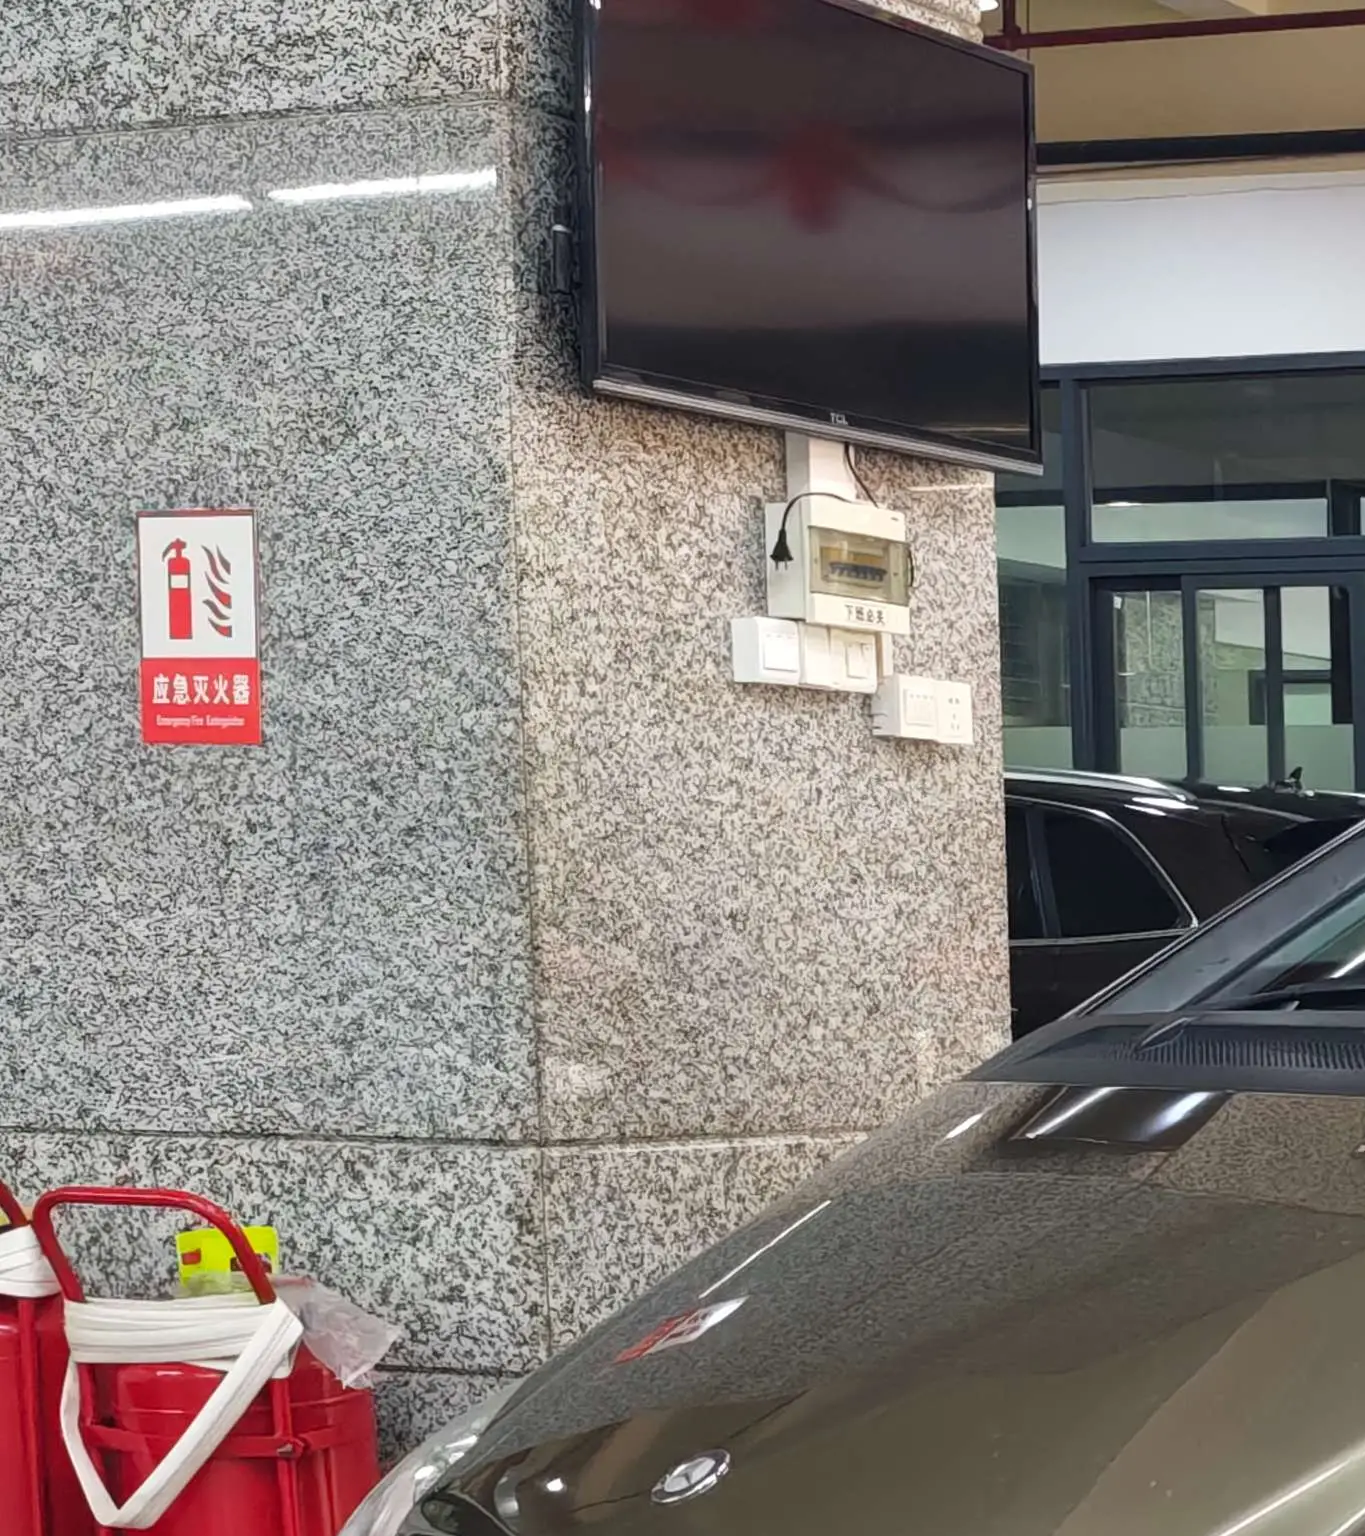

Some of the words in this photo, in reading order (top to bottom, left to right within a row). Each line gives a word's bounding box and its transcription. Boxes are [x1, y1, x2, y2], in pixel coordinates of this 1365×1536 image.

[830, 412, 848, 426] TCL
[152, 673, 250, 705] 应急灭火器
